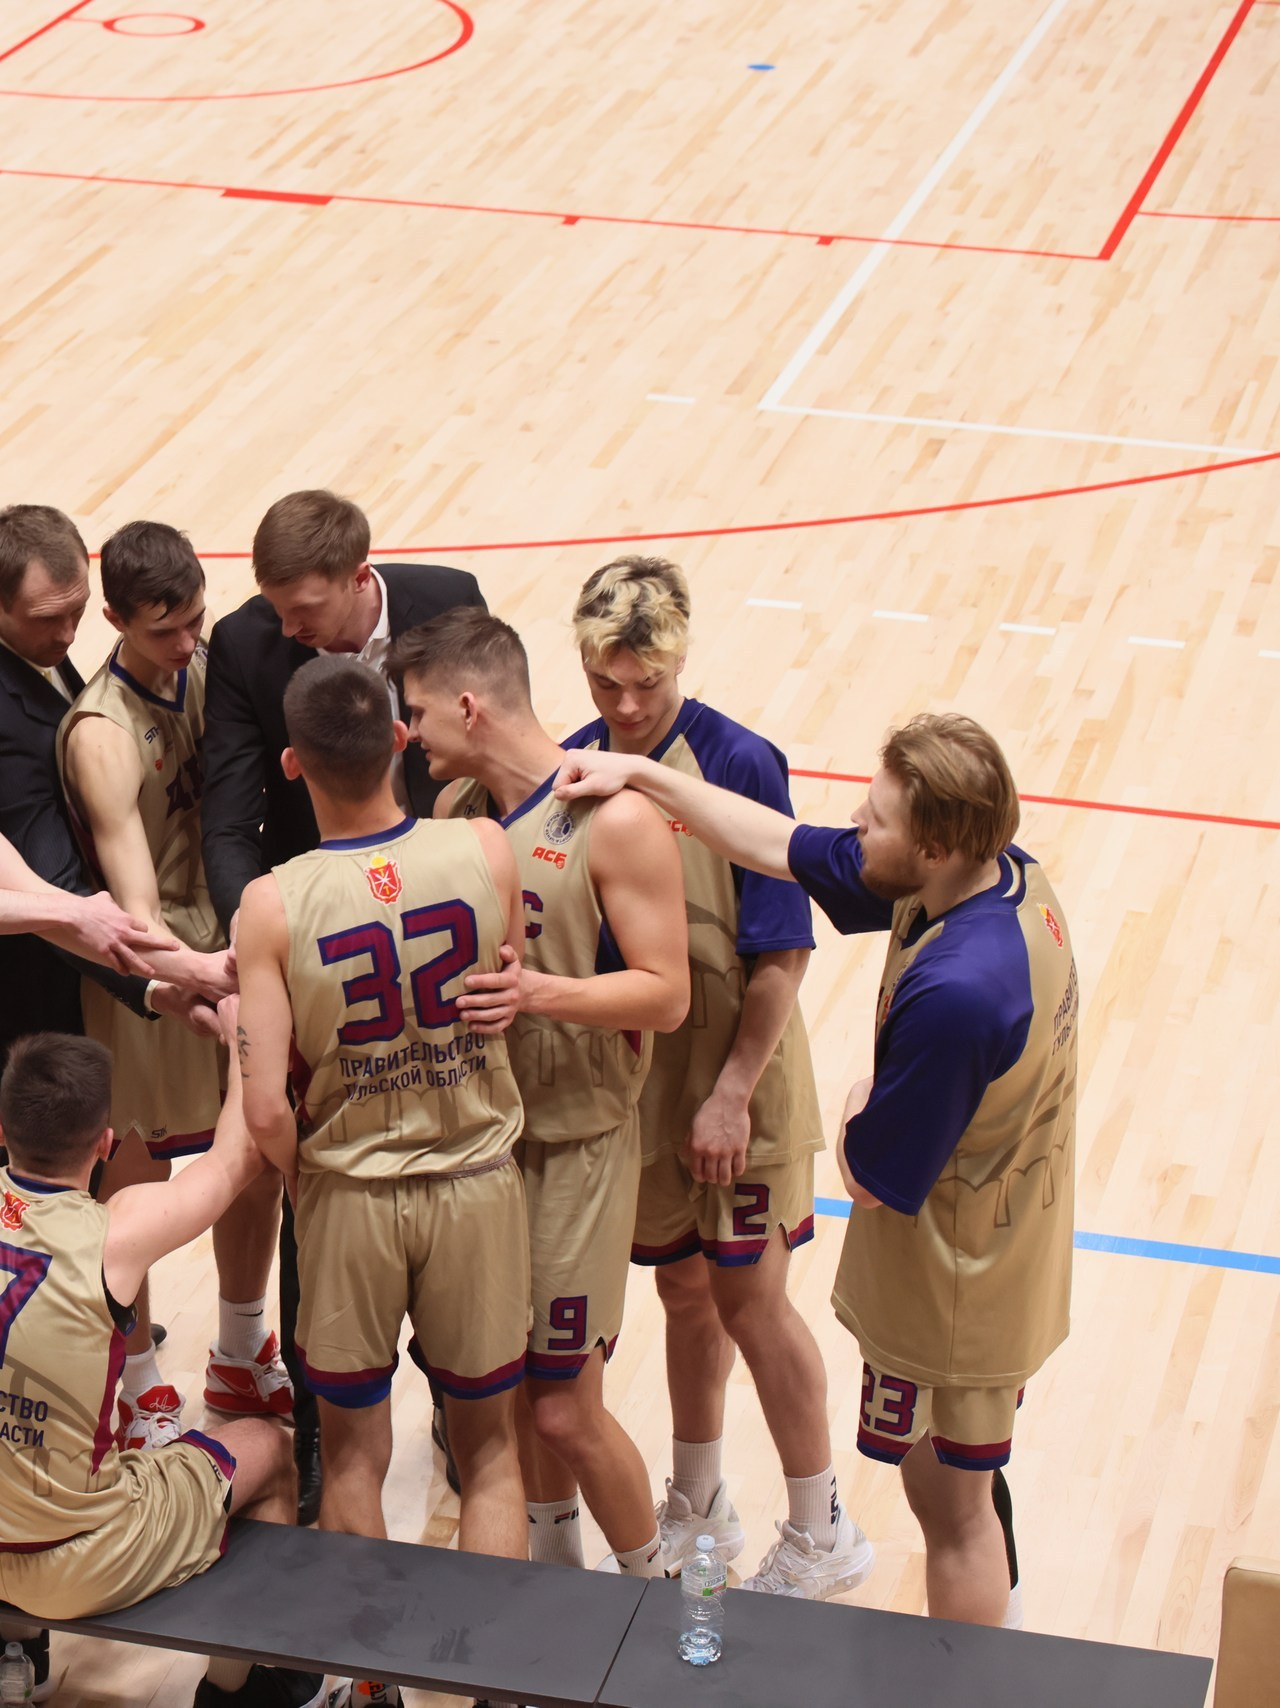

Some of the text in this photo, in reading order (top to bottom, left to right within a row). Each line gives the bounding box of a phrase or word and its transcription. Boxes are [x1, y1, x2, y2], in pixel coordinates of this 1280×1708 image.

[317, 898, 480, 1045] 32
[339, 1032, 486, 1078] ПРАВИТЕЛЬСТВО
[426, 1055, 487, 1088] ОБЛАСТИ
[732, 1182, 770, 1237] 2
[547, 1295, 589, 1351] 9
